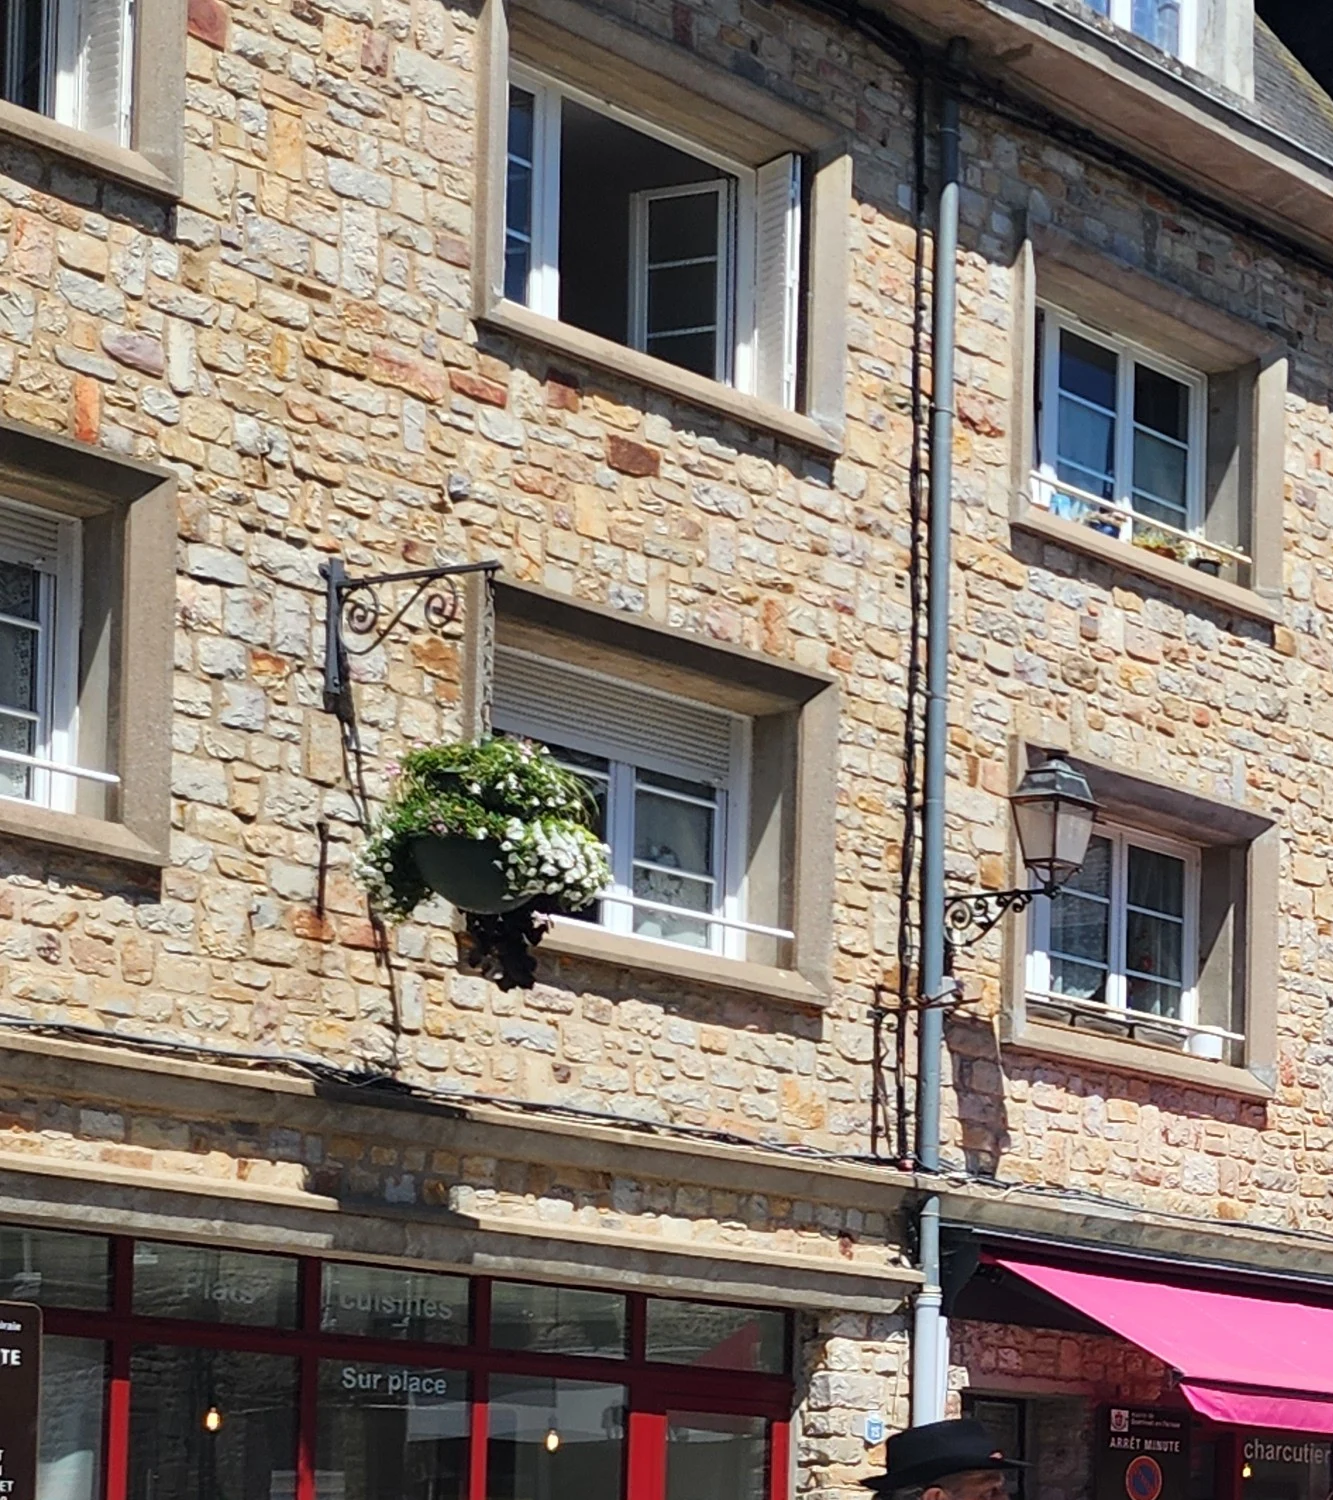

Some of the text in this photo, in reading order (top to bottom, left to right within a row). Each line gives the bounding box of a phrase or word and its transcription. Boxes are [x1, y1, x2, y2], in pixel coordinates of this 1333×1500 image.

[342, 1367, 447, 1395] Sur place
[1109, 1435, 1181, 1453] ARRÊT MINUTE
[1243, 1438, 1332, 1464] charcutier
